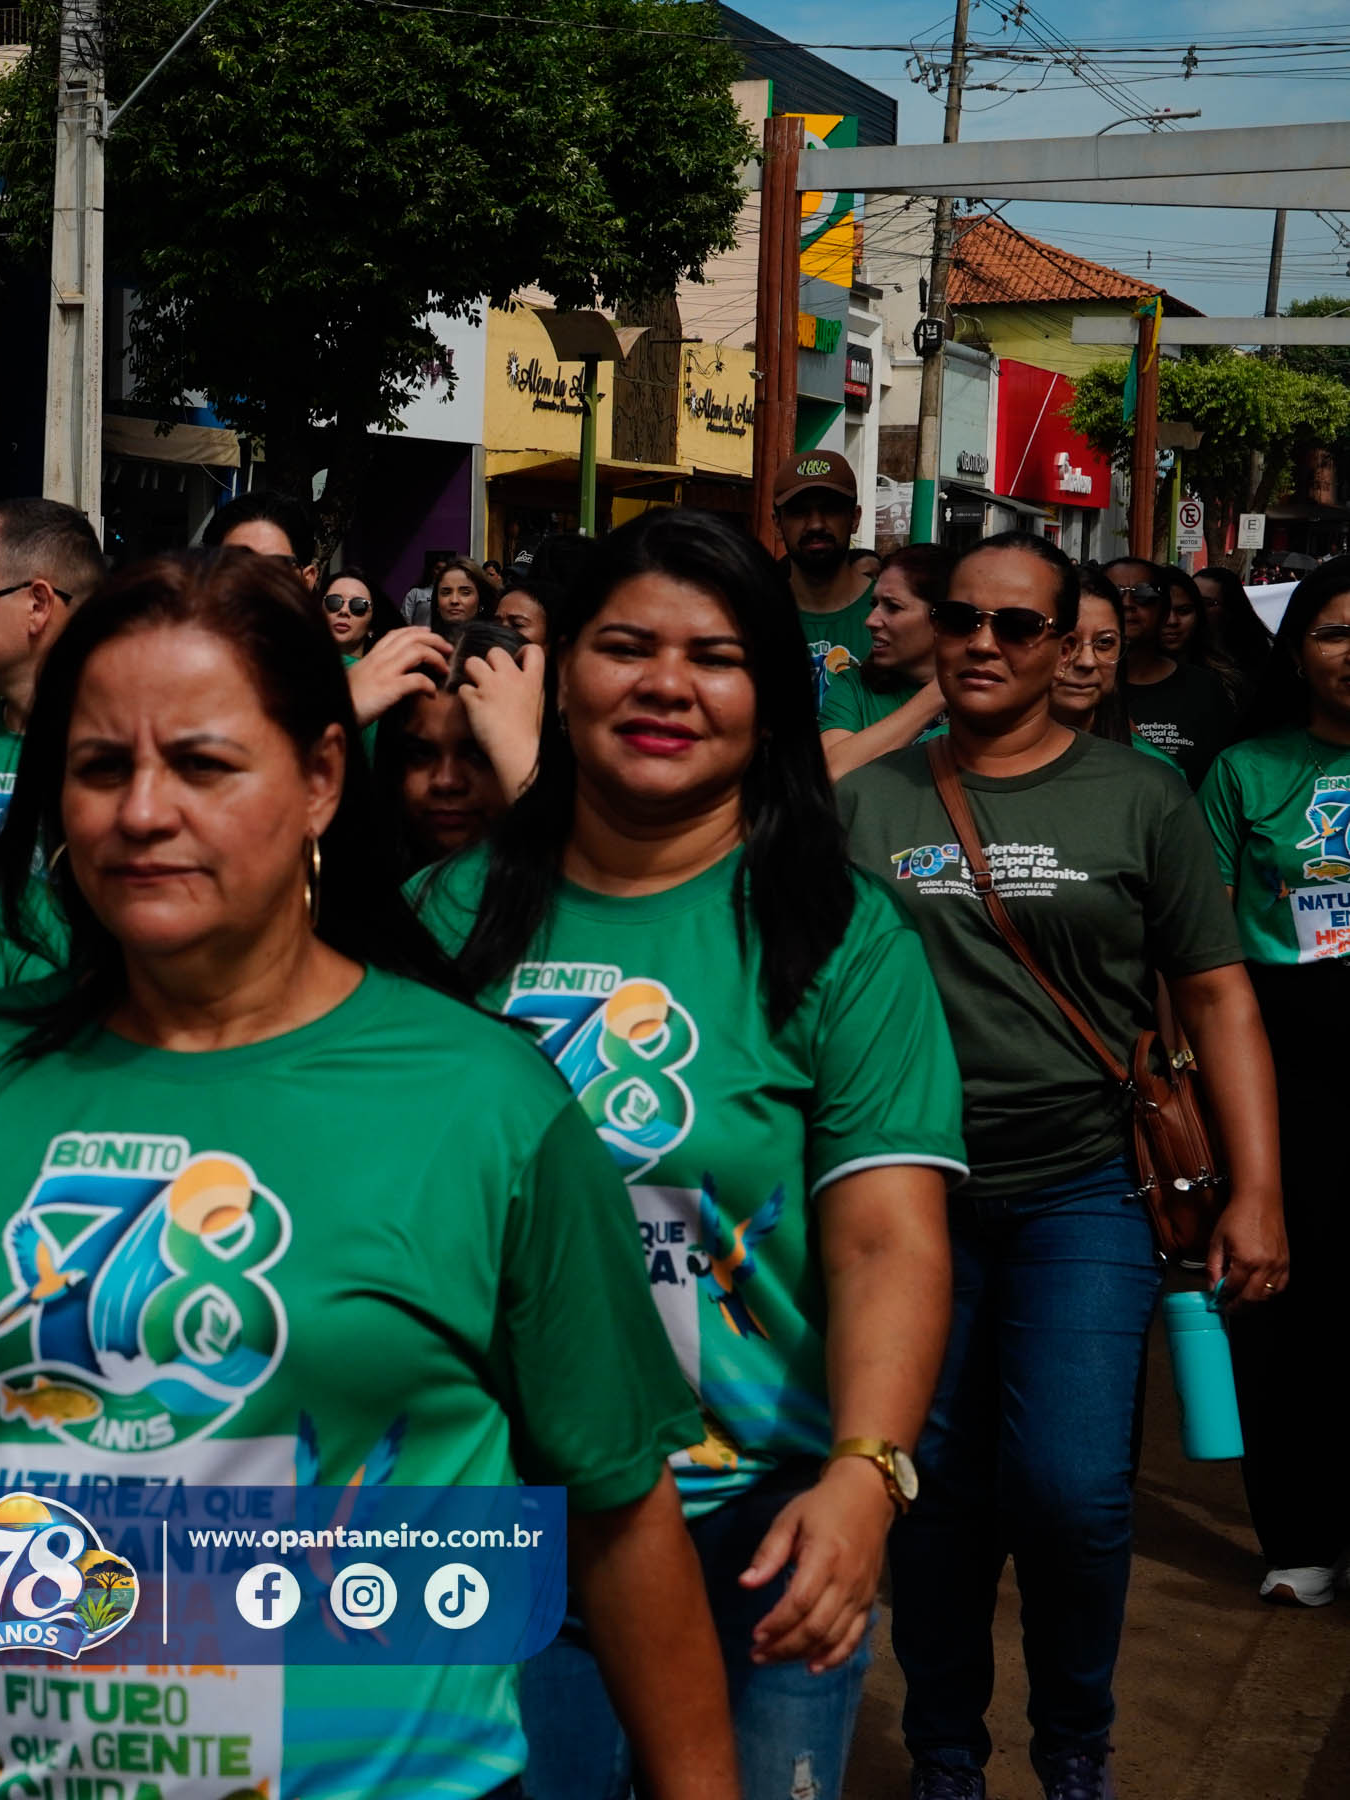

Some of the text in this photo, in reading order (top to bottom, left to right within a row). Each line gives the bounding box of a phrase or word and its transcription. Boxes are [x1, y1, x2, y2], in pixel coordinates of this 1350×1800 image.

[1165, 736, 1194, 746] Bonito
[1167, 729, 1179, 737] de
[1008, 864, 1029, 879] de
[1032, 865, 1089, 882] Bonito
[1036, 856, 1058, 868] de
[920, 887, 949, 896] CUIDAR
[950, 888, 963, 896] DO
[1015, 889, 1026, 897] DO
[517, 968, 615, 993] BONITO
[51, 1138, 183, 1171] BONITO
[638, 1221, 686, 1249] QUE
[89, 1413, 174, 1451] ANOS
[5, 1674, 188, 1726] FUTURO
[10, 1732, 251, 1777] QUE A GENTE
